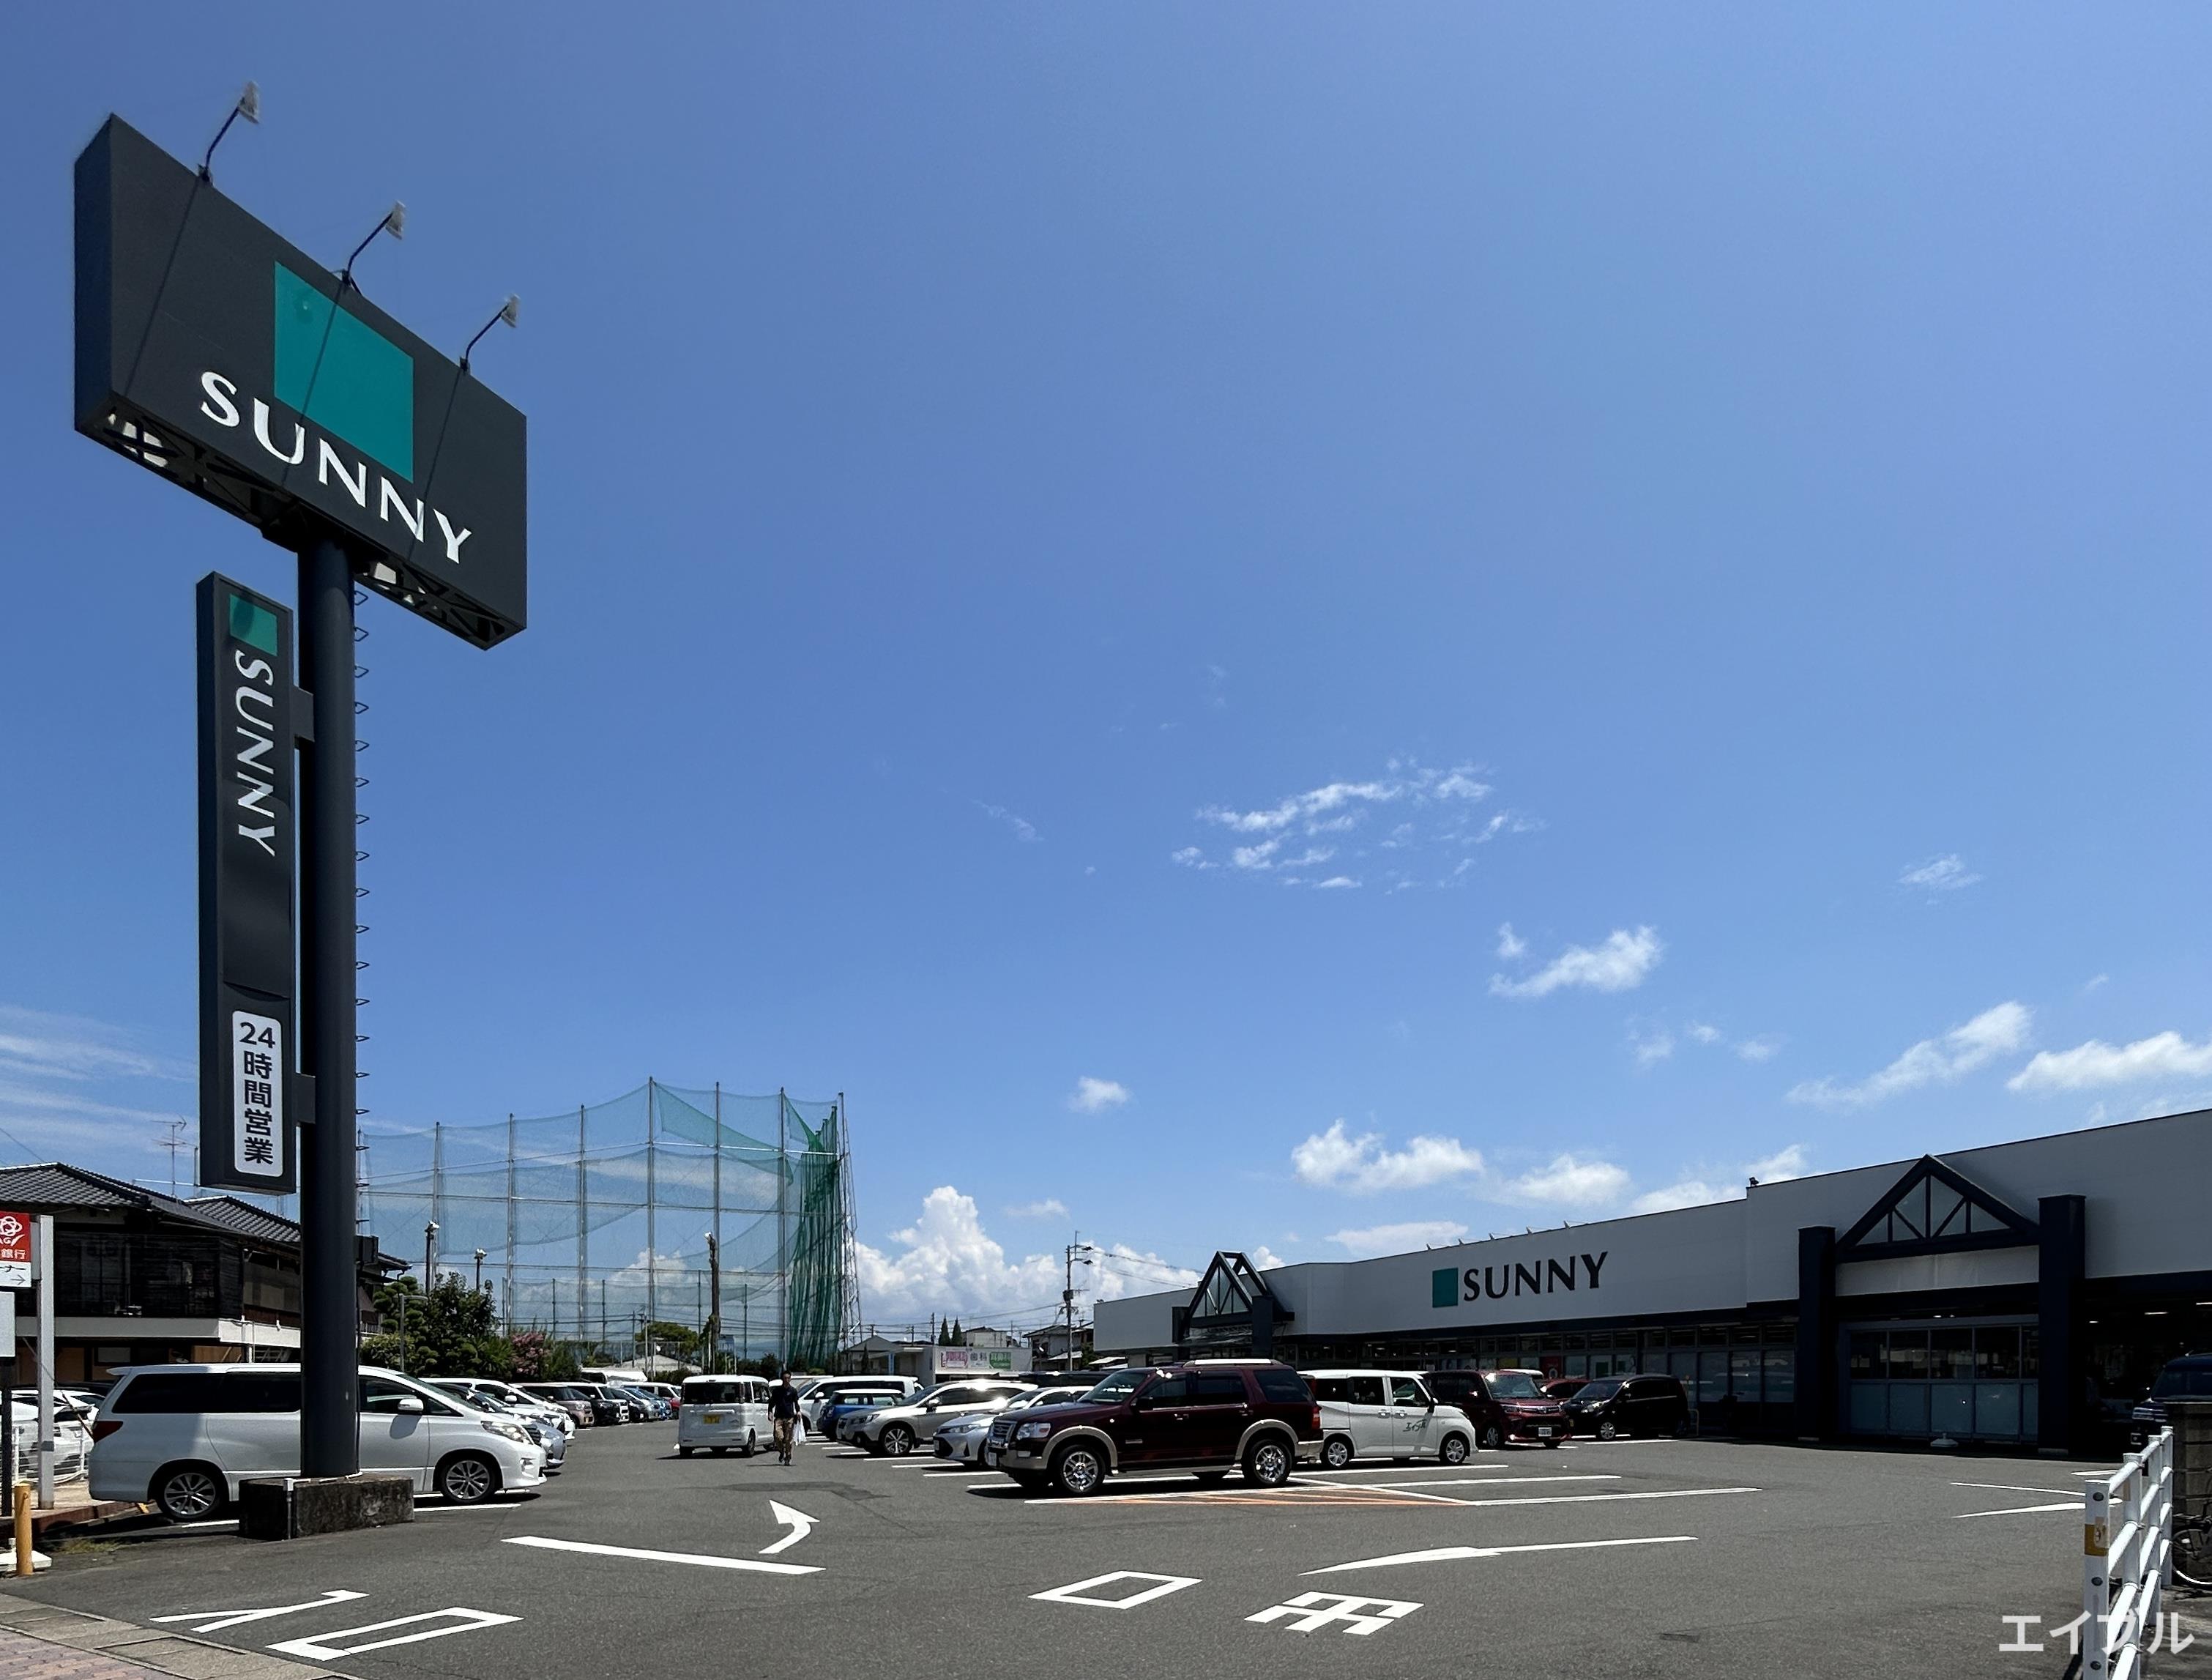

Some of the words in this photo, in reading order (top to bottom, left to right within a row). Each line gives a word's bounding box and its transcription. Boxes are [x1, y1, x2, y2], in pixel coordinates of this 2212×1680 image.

[201, 371, 471, 563] SUNNY
[236, 650, 275, 856] SUNNY
[239, 1022, 275, 1165] 24時間営業
[1463, 1252, 1608, 1302] SUNNY
